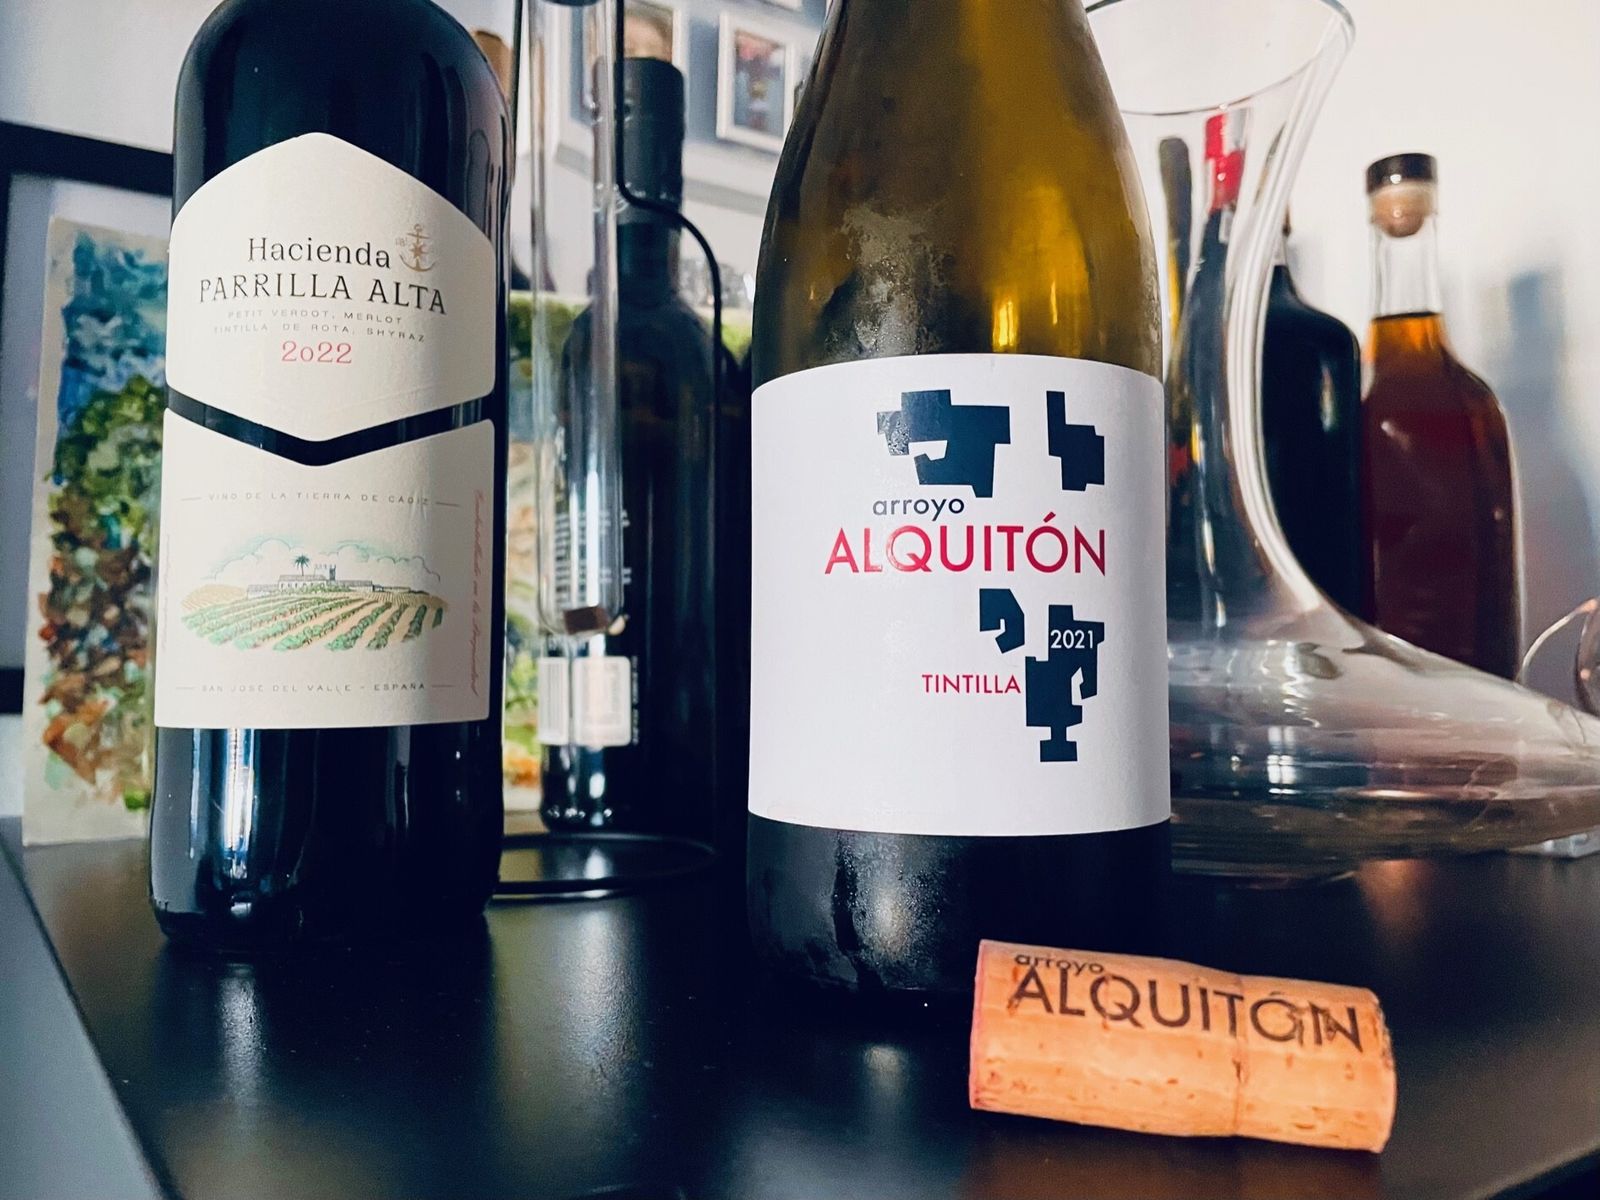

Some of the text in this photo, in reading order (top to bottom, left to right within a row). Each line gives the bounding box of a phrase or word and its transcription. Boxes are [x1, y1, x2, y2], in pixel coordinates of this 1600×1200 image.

[247, 237, 391, 269] Hacienda
[199, 273, 447, 315] PARRILLA ALTA
[228, 310, 263, 319] PETIT
[344, 312, 402, 324] MERLOT
[283, 323, 300, 331] DE
[367, 327, 425, 342] SHYRAZ
[281, 340, 353, 364] 2022
[208, 491, 237, 501] VINO
[245, 491, 261, 500] DE
[271, 492, 287, 500] LA
[297, 491, 351, 500] TIERRA
[361, 494, 378, 503] DE
[872, 498, 964, 521] arroyo
[825, 511, 1106, 577] ALQUITÓN
[1050, 629, 1094, 649] 2021
[202, 684, 223, 693] SAN
[272, 684, 298, 693] DEL
[307, 684, 350, 693] VALLE
[922, 673, 1021, 694] TINTILLA
[1014, 954, 1105, 976] arroyo
[1006, 965, 1364, 1054] ALQUITÓN
